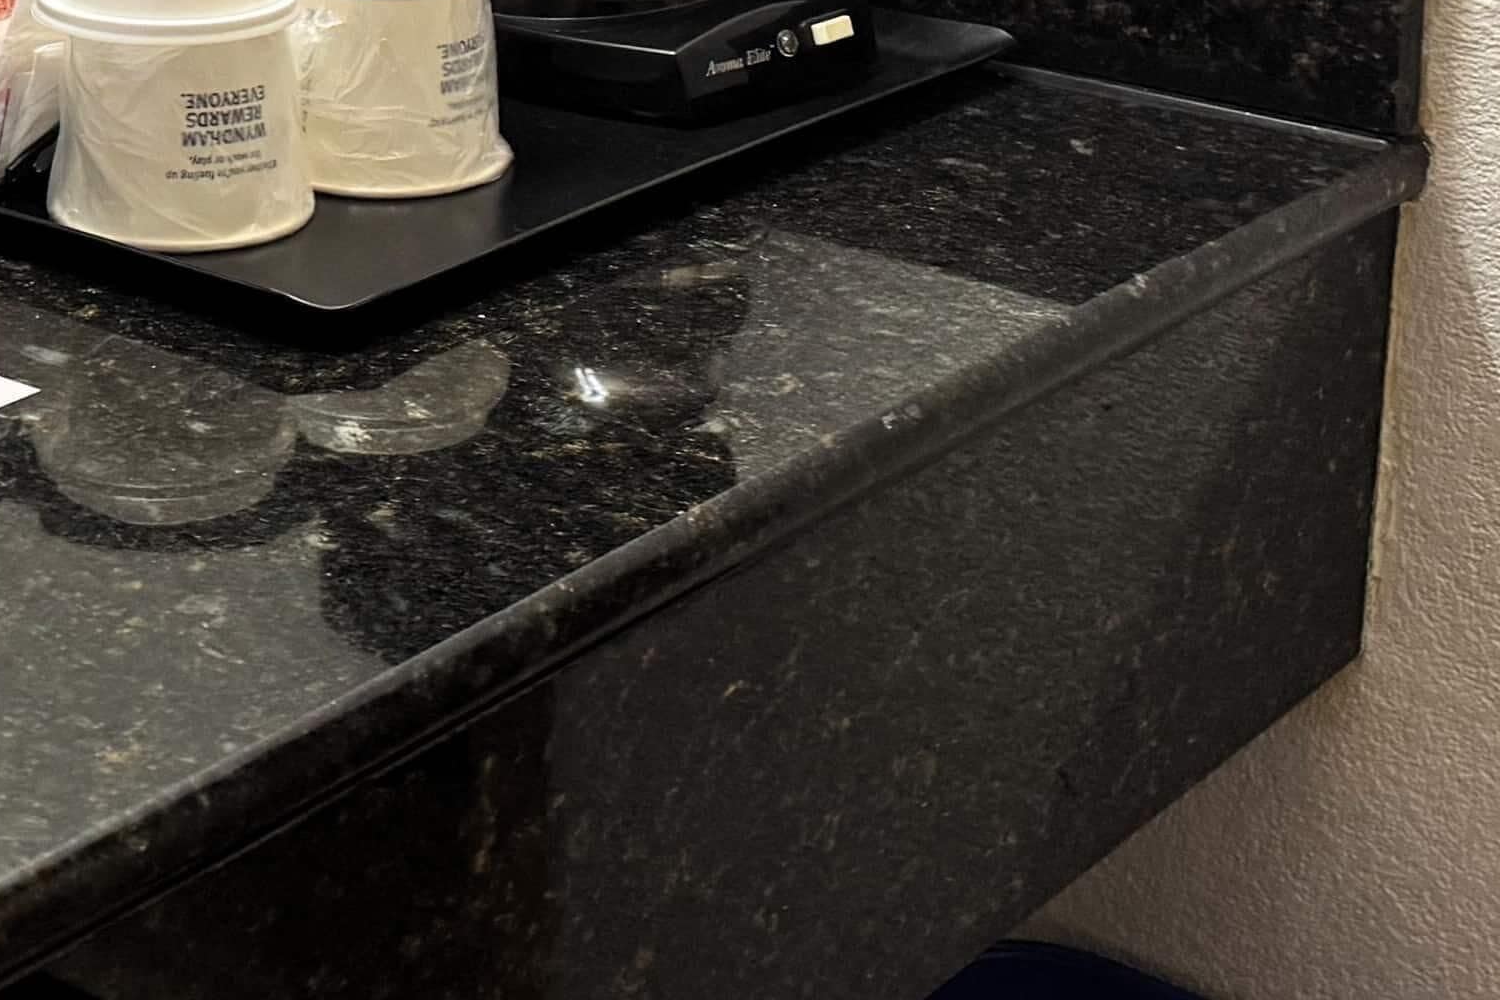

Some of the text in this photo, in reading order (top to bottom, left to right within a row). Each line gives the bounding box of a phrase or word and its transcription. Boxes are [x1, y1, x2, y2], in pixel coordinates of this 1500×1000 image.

[705, 58, 744, 77] Aroma
[180, 85, 266, 109] EVERYONE.
[185, 104, 262, 128] REWARDS
[181, 122, 267, 147] WYNDHAM
[189, 154, 212, 167] play.
[214, 155, 224, 165] or
[166, 170, 179, 180] up
[180, 168, 214, 182] fueling
